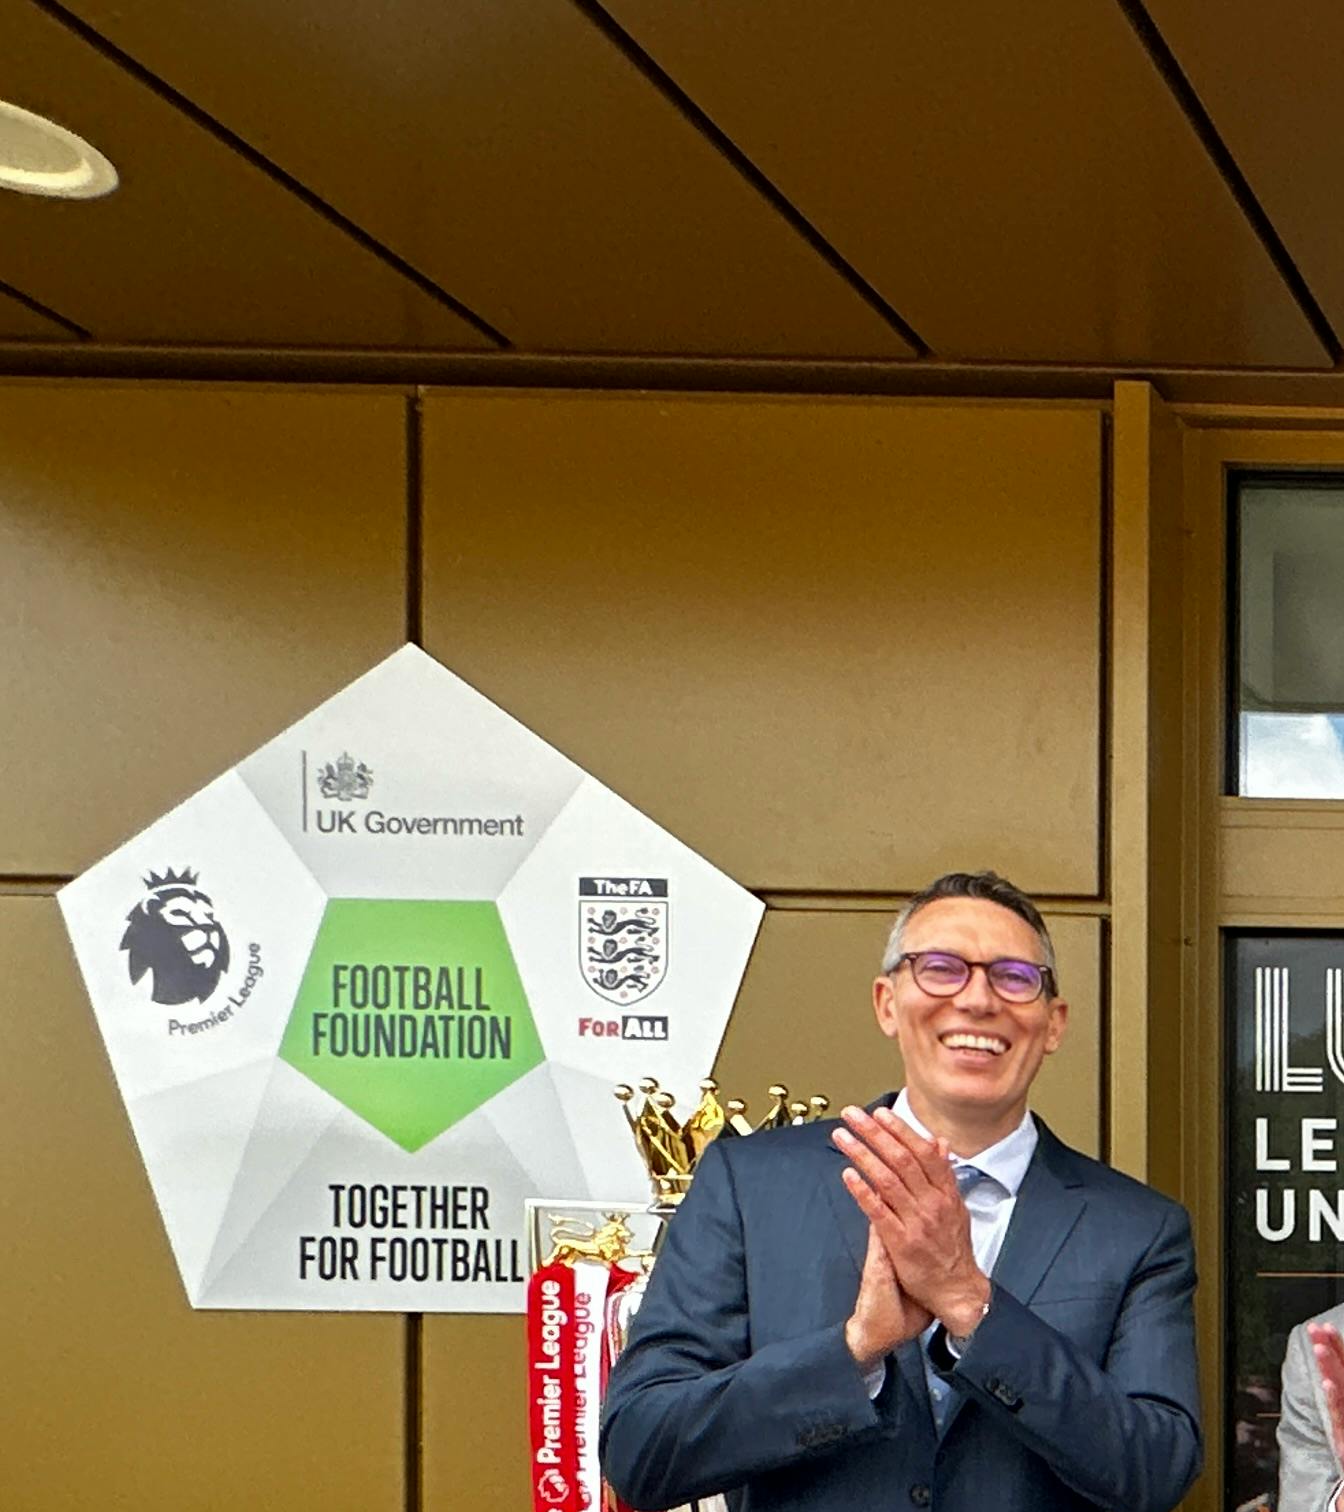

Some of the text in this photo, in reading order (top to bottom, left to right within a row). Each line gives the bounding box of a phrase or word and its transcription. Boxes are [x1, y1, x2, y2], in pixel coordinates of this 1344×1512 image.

[316, 810, 524, 836] UK Government
[169, 942, 264, 1035] Premier League
[333, 964, 490, 1011] FOOTBALL
[313, 1013, 511, 1060] FOUNDATION
[329, 1184, 489, 1230] TOGETHER
[299, 1236, 524, 1283] FOR FOOTBALL
[535, 1280, 568, 1370] League
[536, 1375, 562, 1464] Premier
